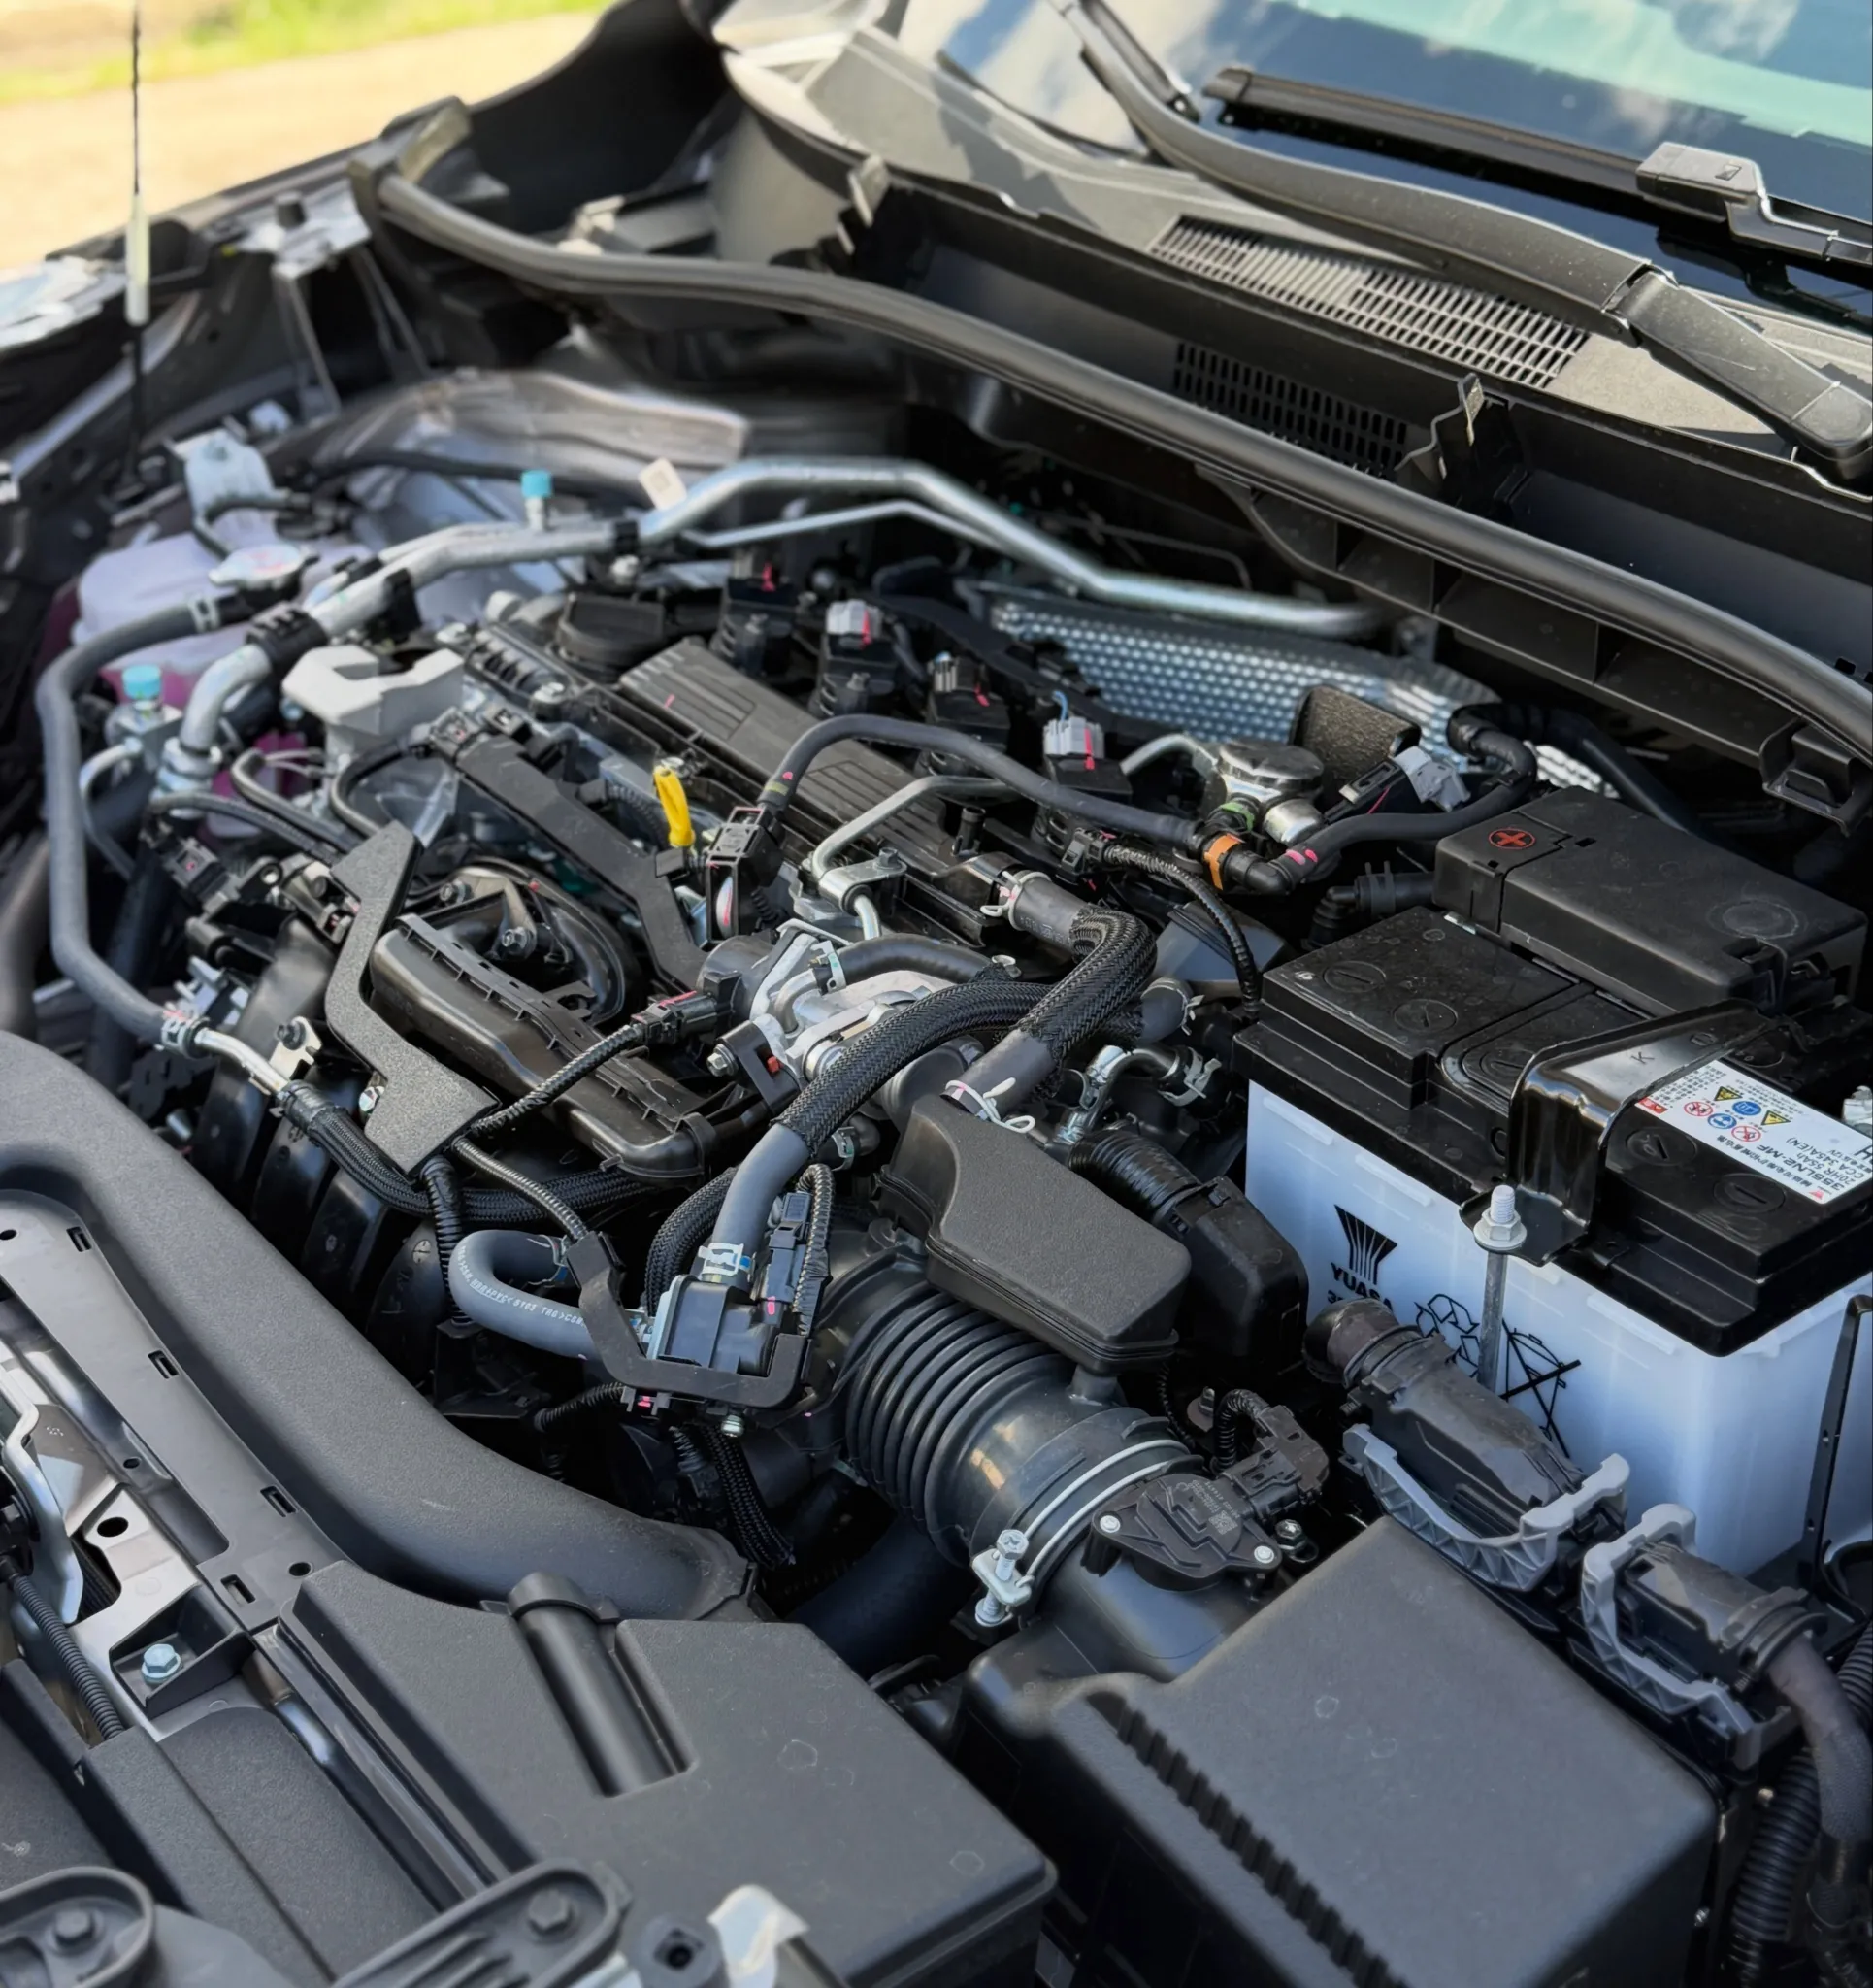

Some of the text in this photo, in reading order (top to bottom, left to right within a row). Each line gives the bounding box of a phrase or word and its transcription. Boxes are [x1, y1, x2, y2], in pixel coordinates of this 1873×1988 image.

[1793, 1152, 1856, 1185] 20HR 55Ah
[1837, 1163, 1865, 1179] CCA
